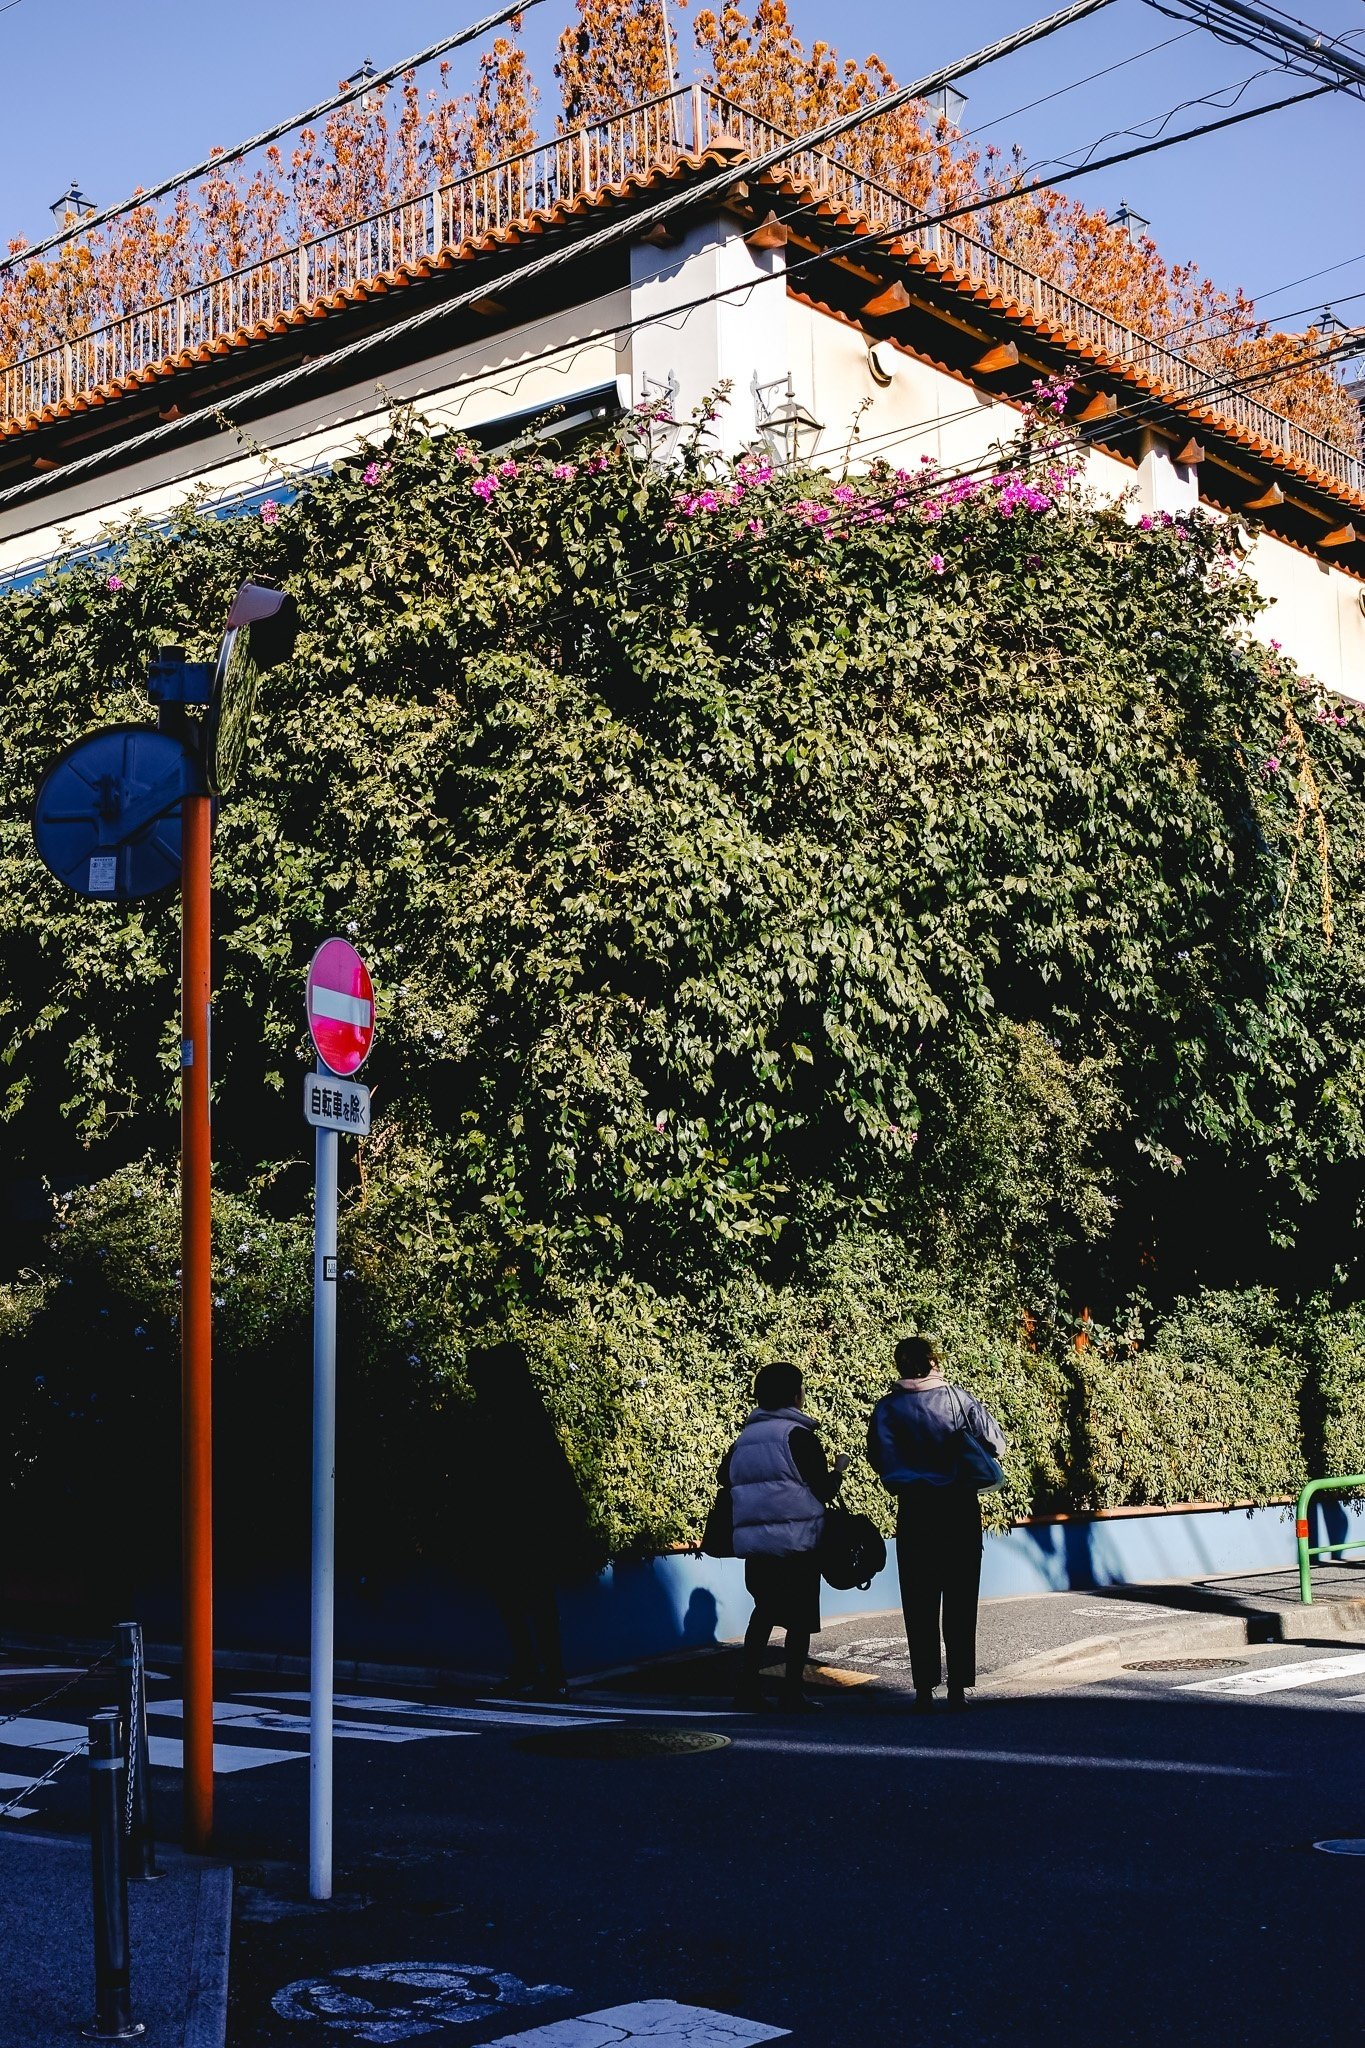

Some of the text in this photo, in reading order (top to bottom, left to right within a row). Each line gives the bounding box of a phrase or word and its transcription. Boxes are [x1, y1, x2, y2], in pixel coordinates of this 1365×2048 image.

[312, 1086, 365, 1124] 自転車を除く
